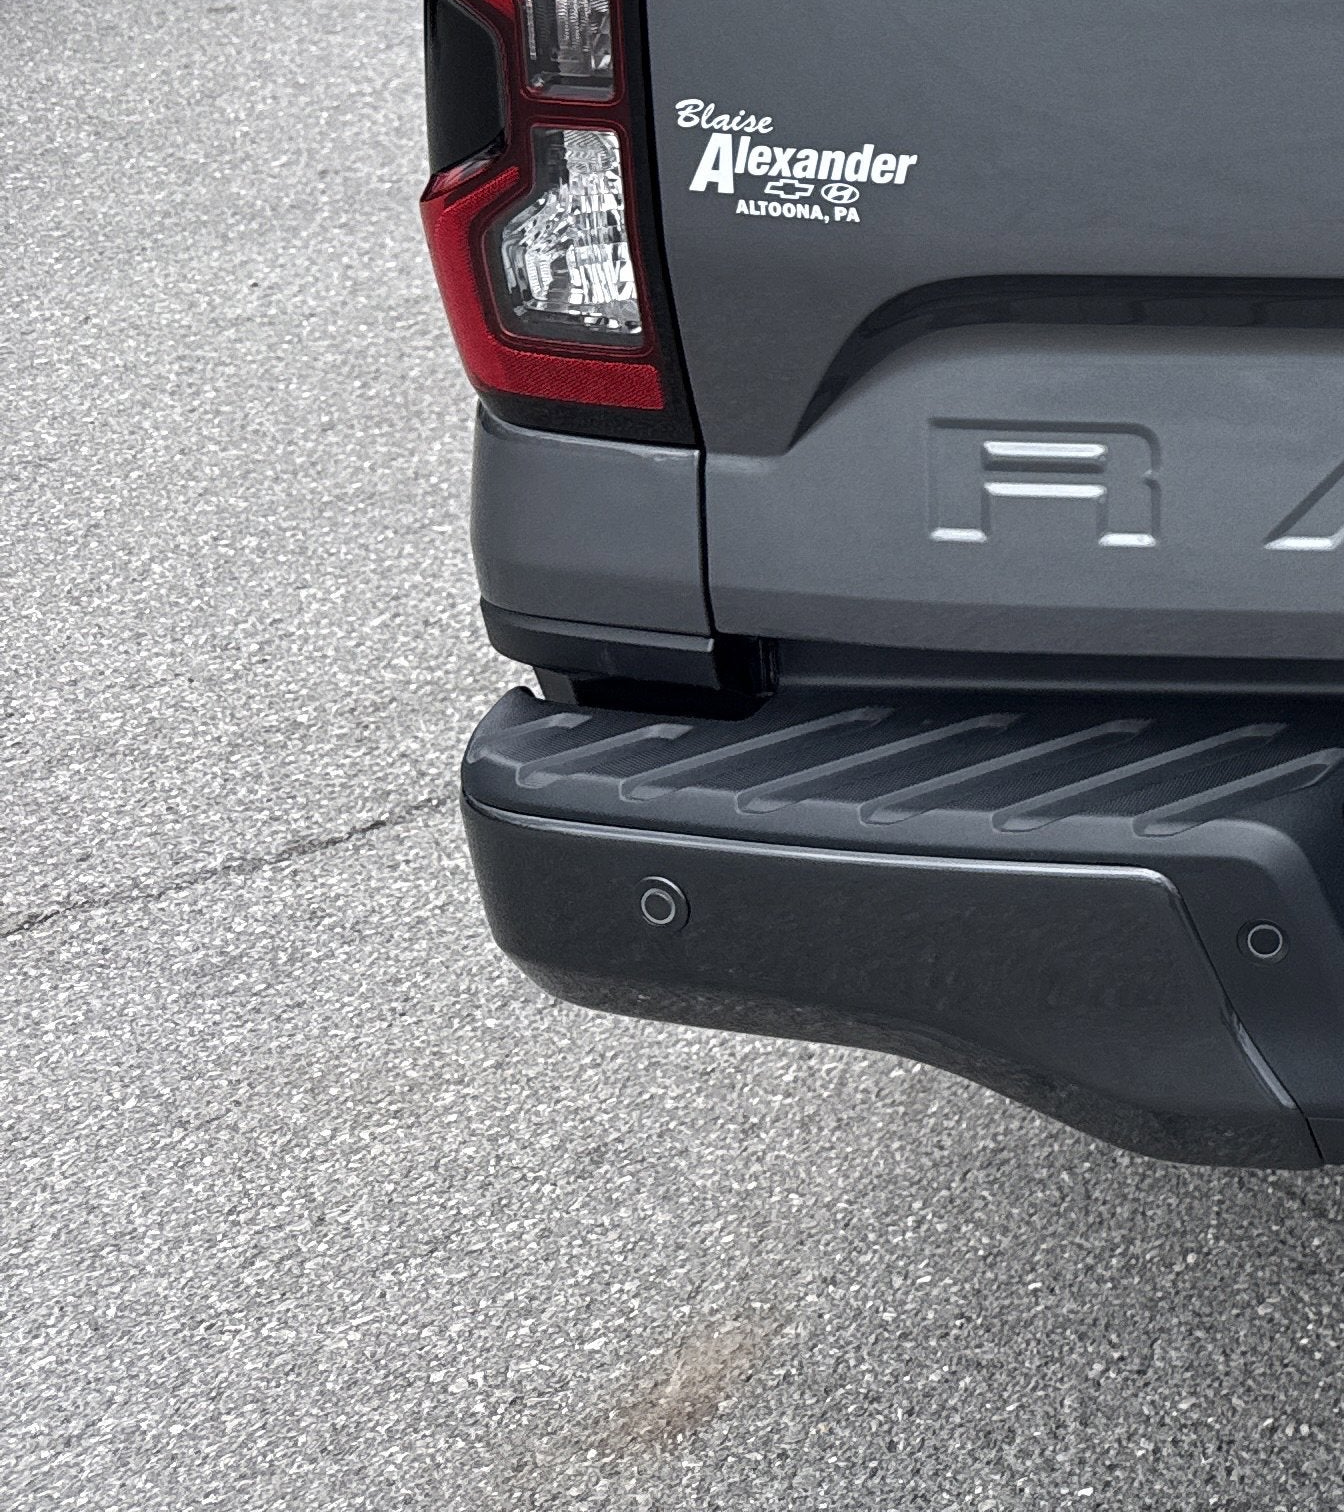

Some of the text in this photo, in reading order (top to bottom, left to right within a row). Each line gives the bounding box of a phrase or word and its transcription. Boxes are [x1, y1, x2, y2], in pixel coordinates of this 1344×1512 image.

[675, 98, 774, 134] Blaise
[689, 132, 917, 193] Alexander
[736, 199, 861, 224] ALTOONA, PA
